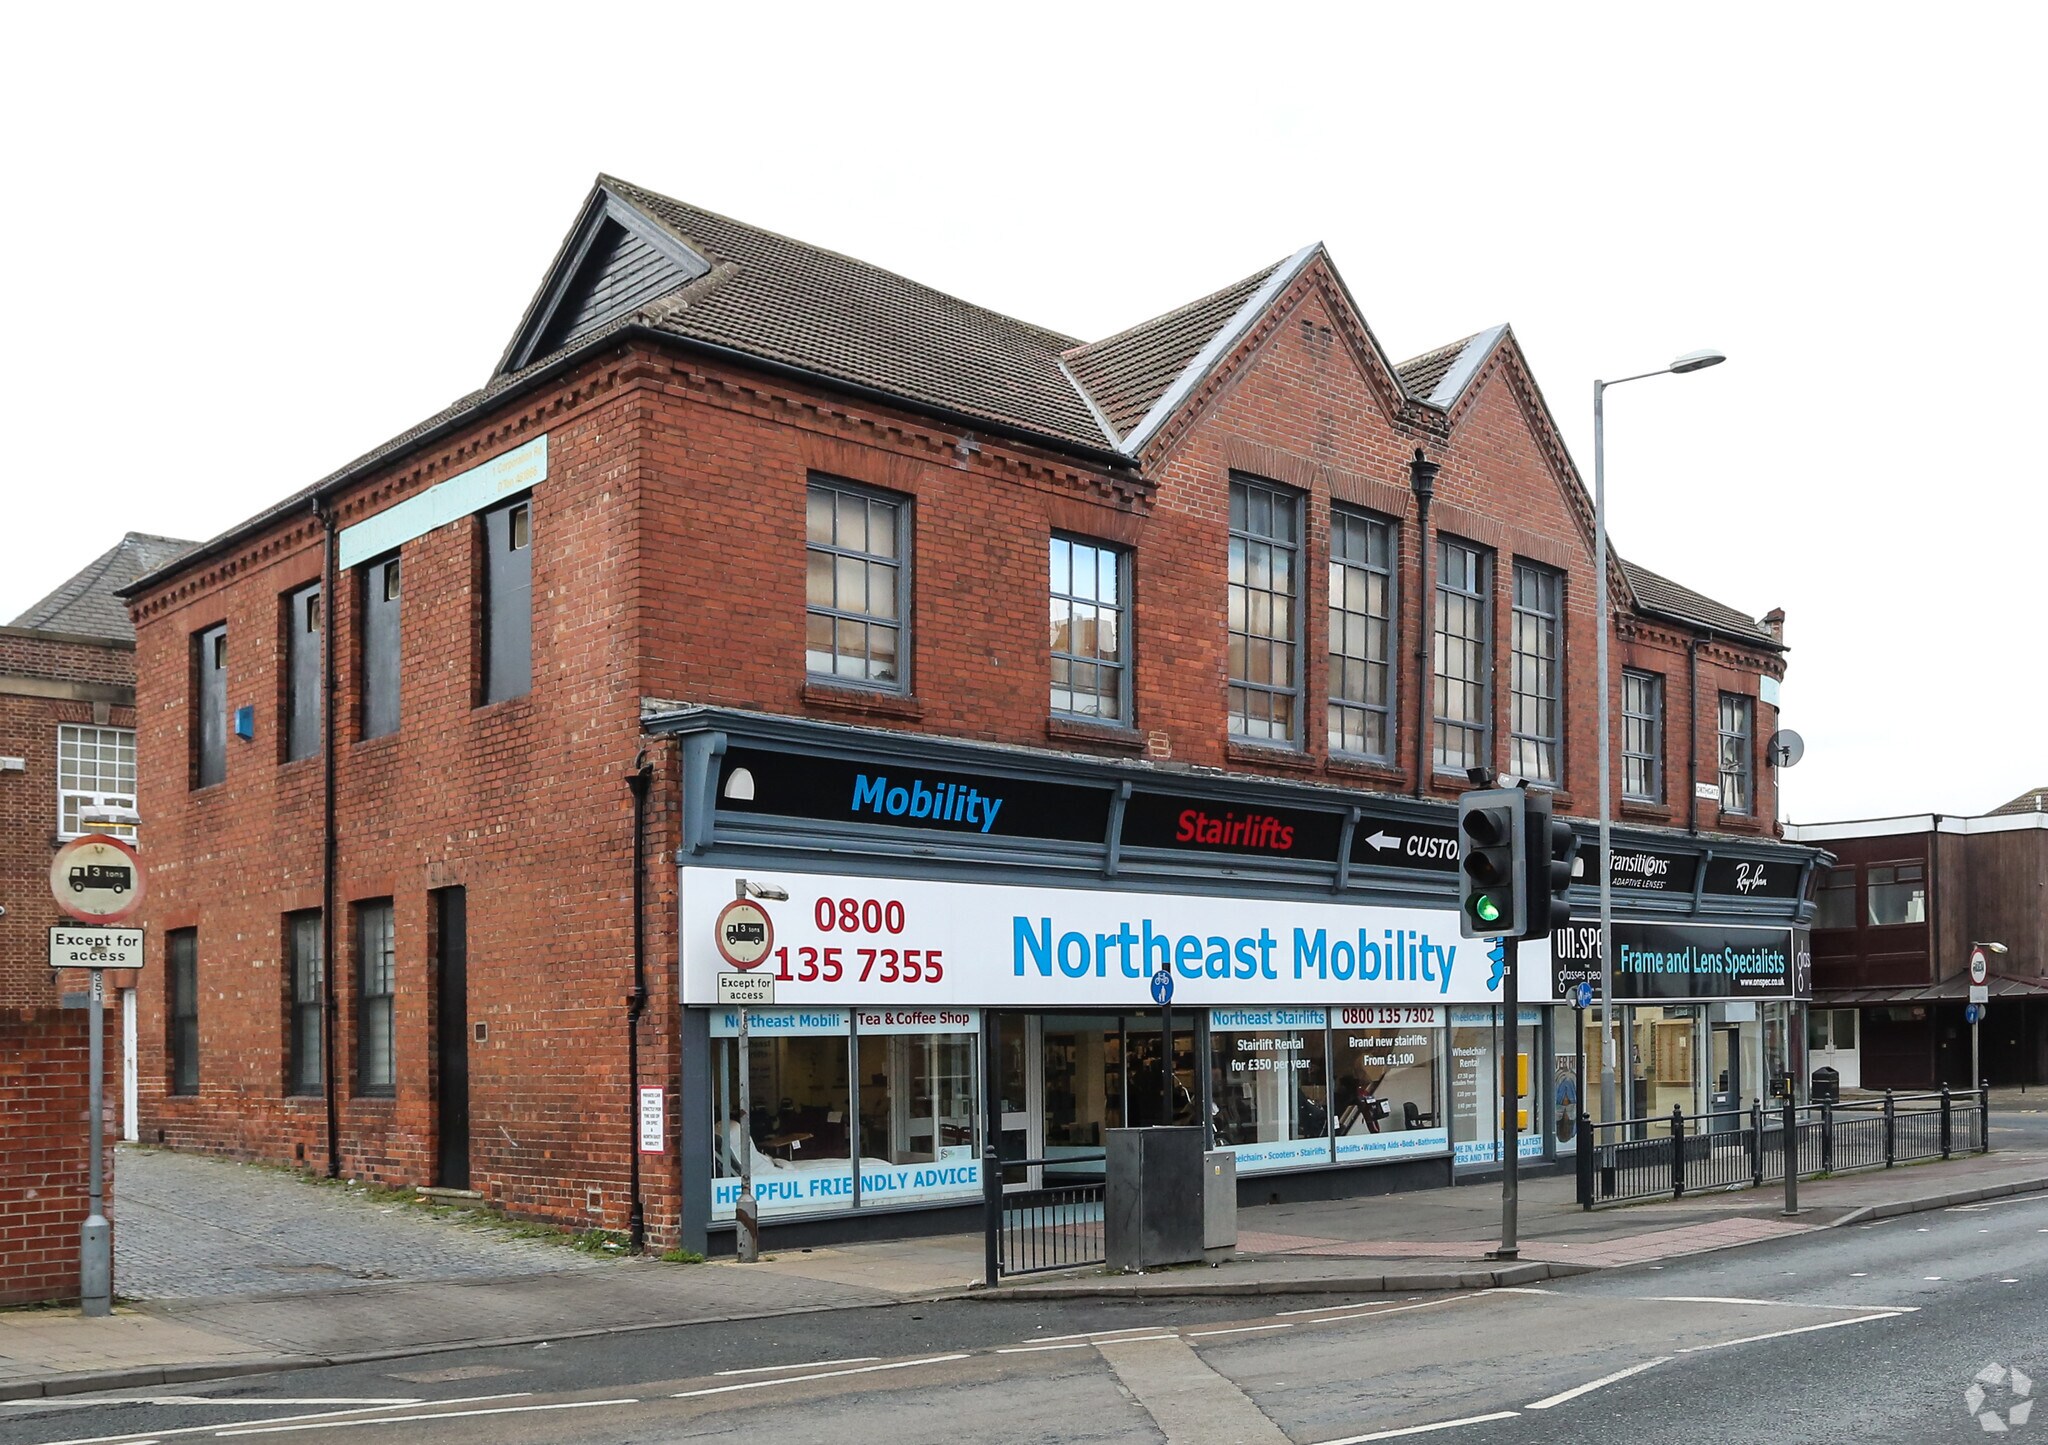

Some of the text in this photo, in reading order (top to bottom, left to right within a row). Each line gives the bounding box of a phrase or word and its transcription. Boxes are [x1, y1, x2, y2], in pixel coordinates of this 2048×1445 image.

[851, 774, 1003, 833] Mobility
[1176, 809, 1294, 850] Stairlifts
[1406, 835, 1460, 860] CUSTO
[93, 868, 124, 878] 3 tons
[1612, 878, 1664, 889] ADAPTIVE LENSES
[815, 897, 905, 934] 0800
[56, 934, 138, 948] Except for
[70, 952, 126, 962] access
[1012, 916, 1457, 994] Northeast Mobility
[1620, 944, 1785, 980] Frame and Lens Specialists
[775, 947, 943, 983] 135 7355
[1797, 940, 1811, 992] glas
[722, 978, 771, 989] Except for
[1558, 964, 1602, 993] glasses peo
[1740, 976, 1785, 988] www.onspec.co.uk
[730, 991, 764, 1000] access
[725, 1014, 795, 1028] Ntheast
[800, 1013, 840, 1028] Mobili
[858, 1011, 970, 1026] Tea & Coffee Shop
[1212, 1009, 1325, 1026] Northeast Stairlifts
[1342, 1007, 1435, 1024] 0800 135 7302
[1237, 1037, 1304, 1051] Stairlift Rental
[1349, 1034, 1427, 1048] Brand new stairlifts
[1452, 1047, 1487, 1056] Wheelchair
[1231, 1058, 1310, 1073] for £350 per year
[1364, 1053, 1415, 1067] From £1,100
[1459, 1058, 1480, 1067] Rental
[1336, 1137, 1447, 1154] Bathlifts Walking Aids Beds Bathrooms
[1475, 1143, 1485, 1151] ASK
[1522, 1137, 1541, 1146] LATEST
[1235, 1147, 1326, 1163] eelchairs Scooters Stairlifts
[1470, 1153, 1482, 1162] AND
[1483, 1152, 1493, 1161] TRY
[1519, 1147, 1531, 1155] YOU
[1532, 1146, 1543, 1154] BUY
[716, 1166, 977, 1204] HEPFUL FRIENDLY ADVICE
